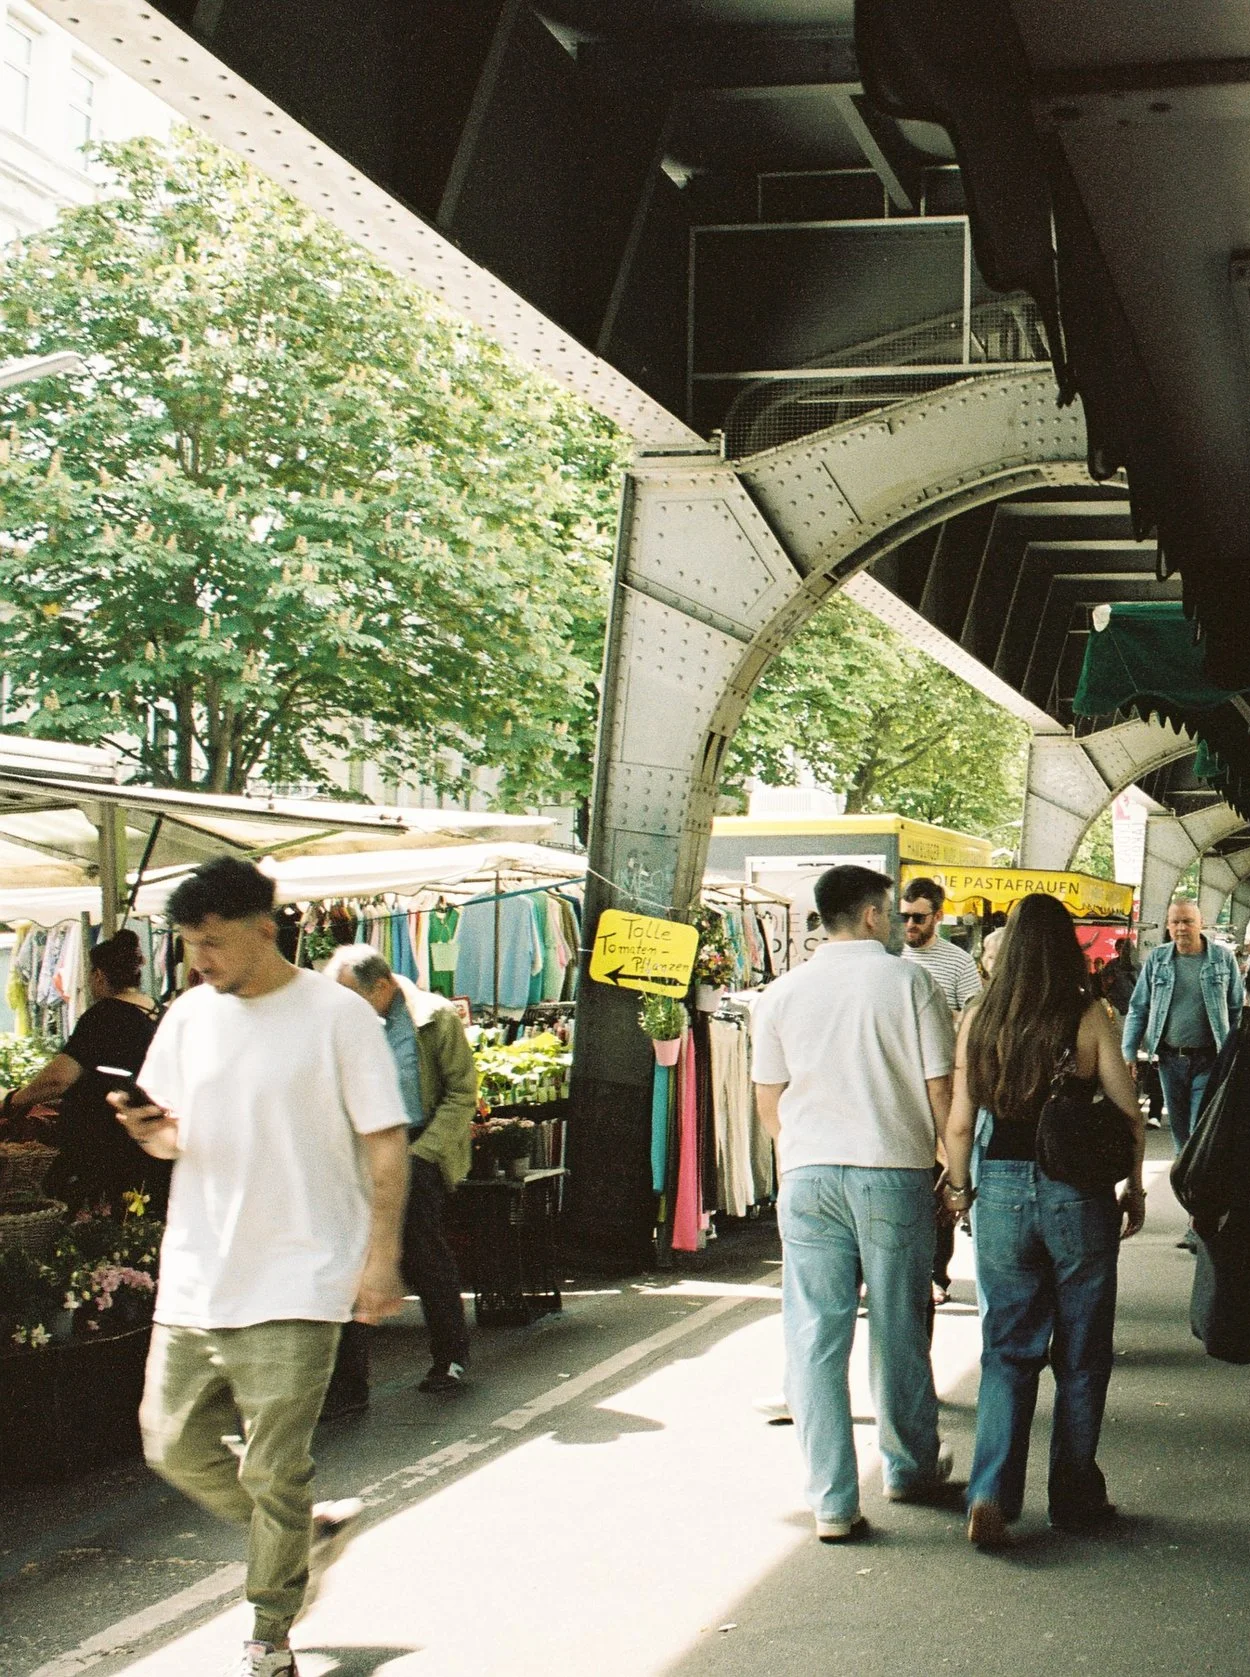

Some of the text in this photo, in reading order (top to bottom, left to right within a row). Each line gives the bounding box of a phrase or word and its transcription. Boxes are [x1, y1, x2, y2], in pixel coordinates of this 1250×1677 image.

[964, 875, 1080, 895] PASTAFRAUEN
[621, 917, 672, 941] Tolle
[631, 956, 690, 974] Pflanzen
